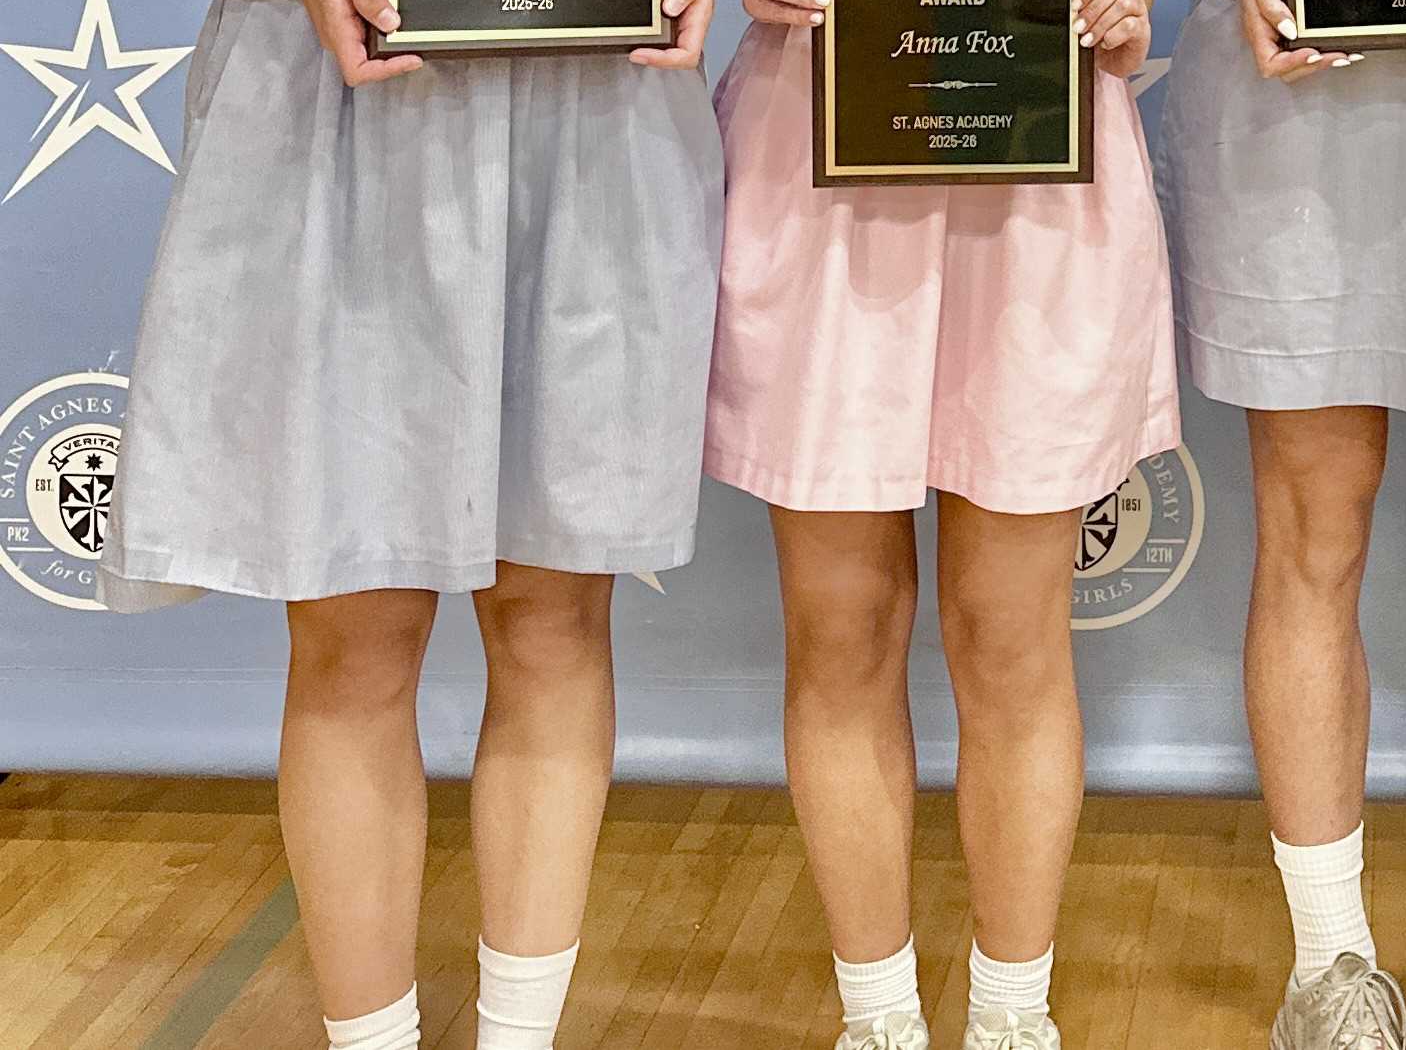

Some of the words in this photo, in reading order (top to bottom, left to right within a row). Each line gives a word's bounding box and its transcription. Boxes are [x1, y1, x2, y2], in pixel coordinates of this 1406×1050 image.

[890, 30, 960, 58] Anna
[966, 30, 1016, 58] Fox
[892, 115, 911, 130] ST.
[913, 115, 954, 130] AGNES
[956, 115, 1013, 130] ACADEMY
[928, 134, 977, 149] 2025-26
[0, 426, 37, 499] SAINT
[38, 398, 114, 431] AGNES
[1121, 498, 1142, 512] 1851
[7, 526, 30, 542] PK2
[1145, 547, 1173, 563] 12TH
[40, 560, 74, 580] for
